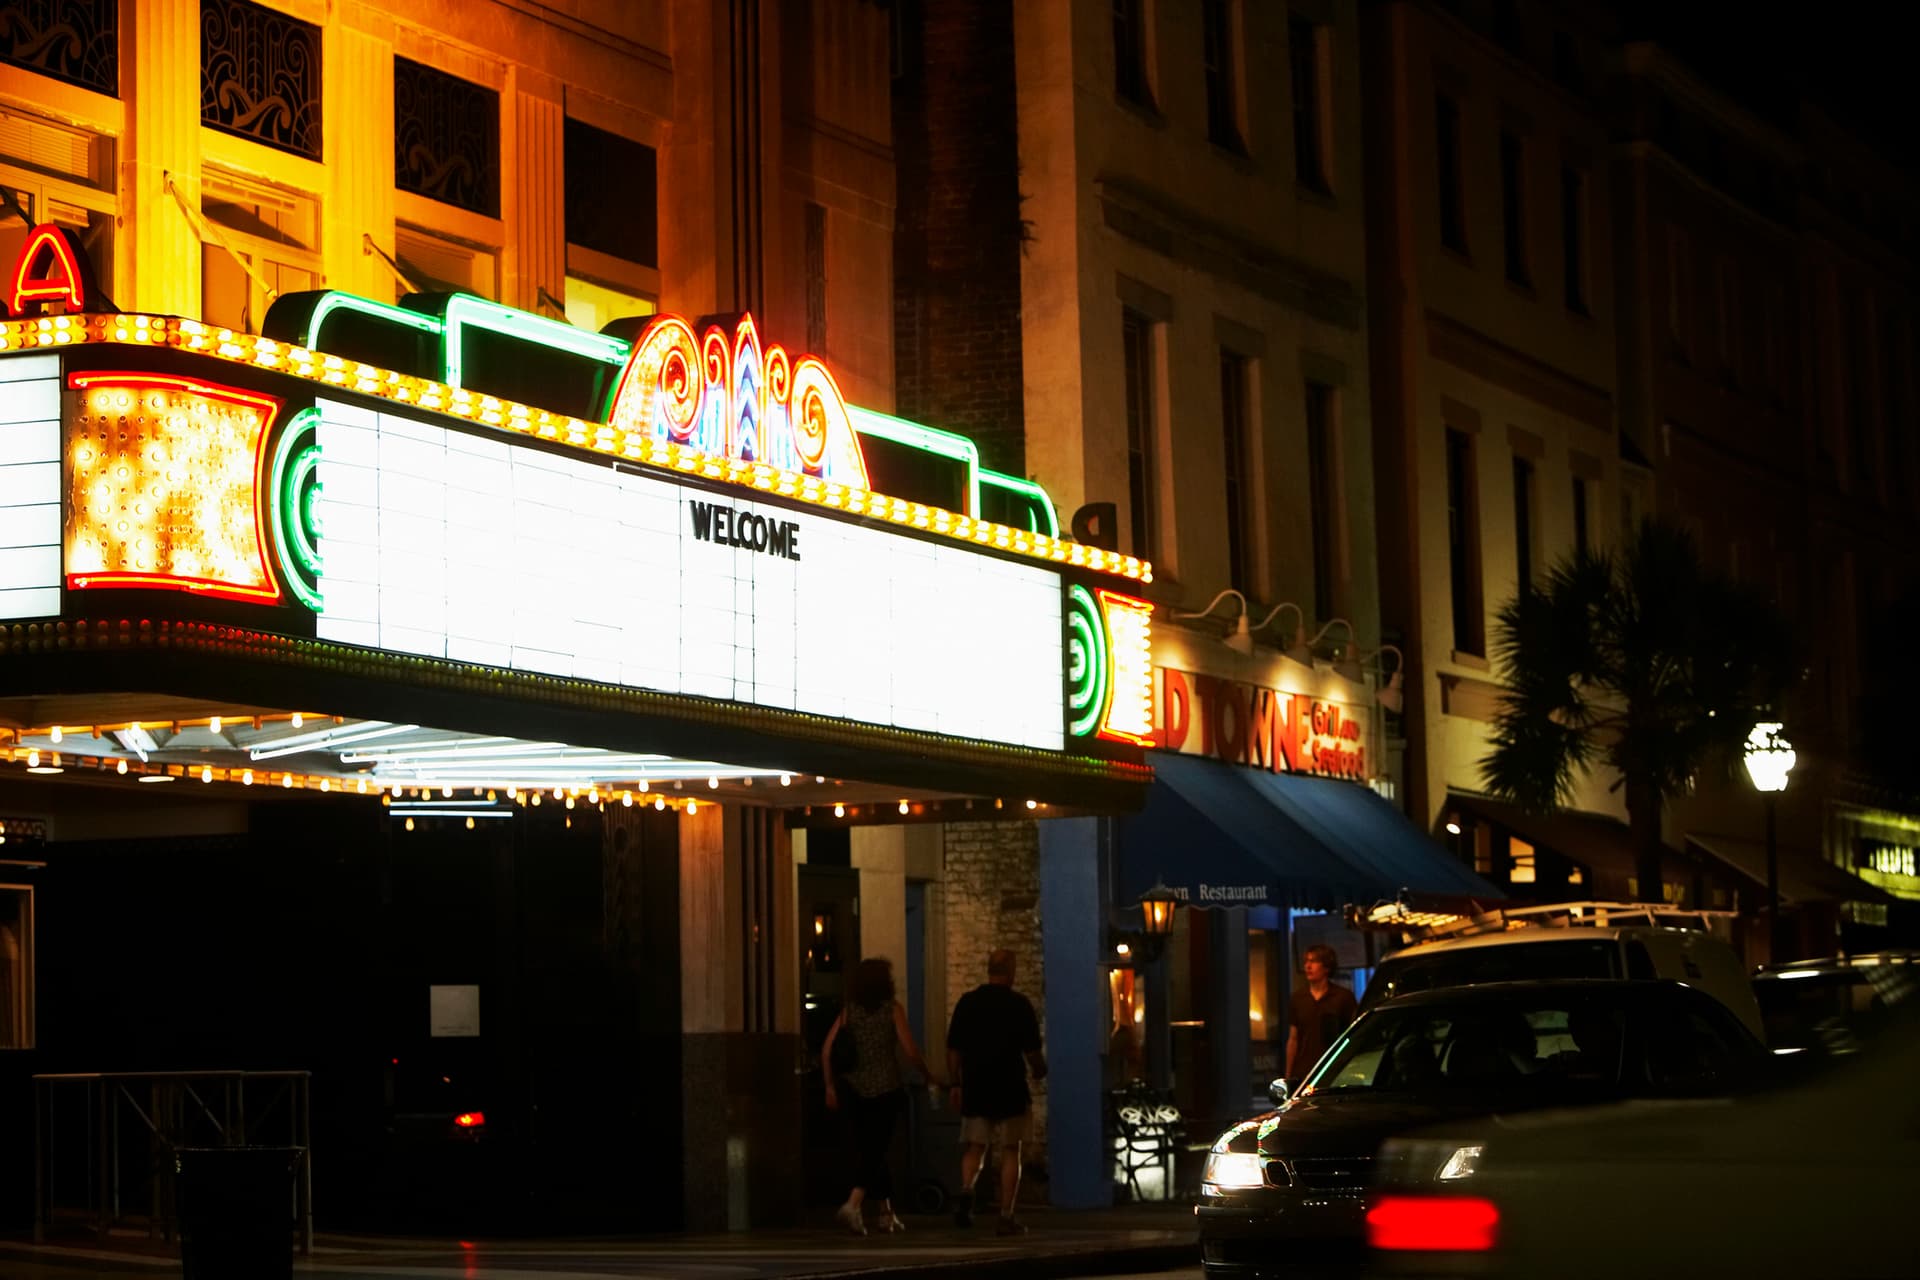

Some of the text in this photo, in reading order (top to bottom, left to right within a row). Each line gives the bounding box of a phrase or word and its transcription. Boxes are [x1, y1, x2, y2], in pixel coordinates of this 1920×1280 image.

[8, 223, 85, 318] A
[690, 500, 800, 561] WELCOME
[1195, 674, 1311, 773] TOWNE
[1312, 702, 1338, 736] Grill
[1312, 740, 1364, 777] Seafood
[1199, 883, 1268, 900] Restaurant
